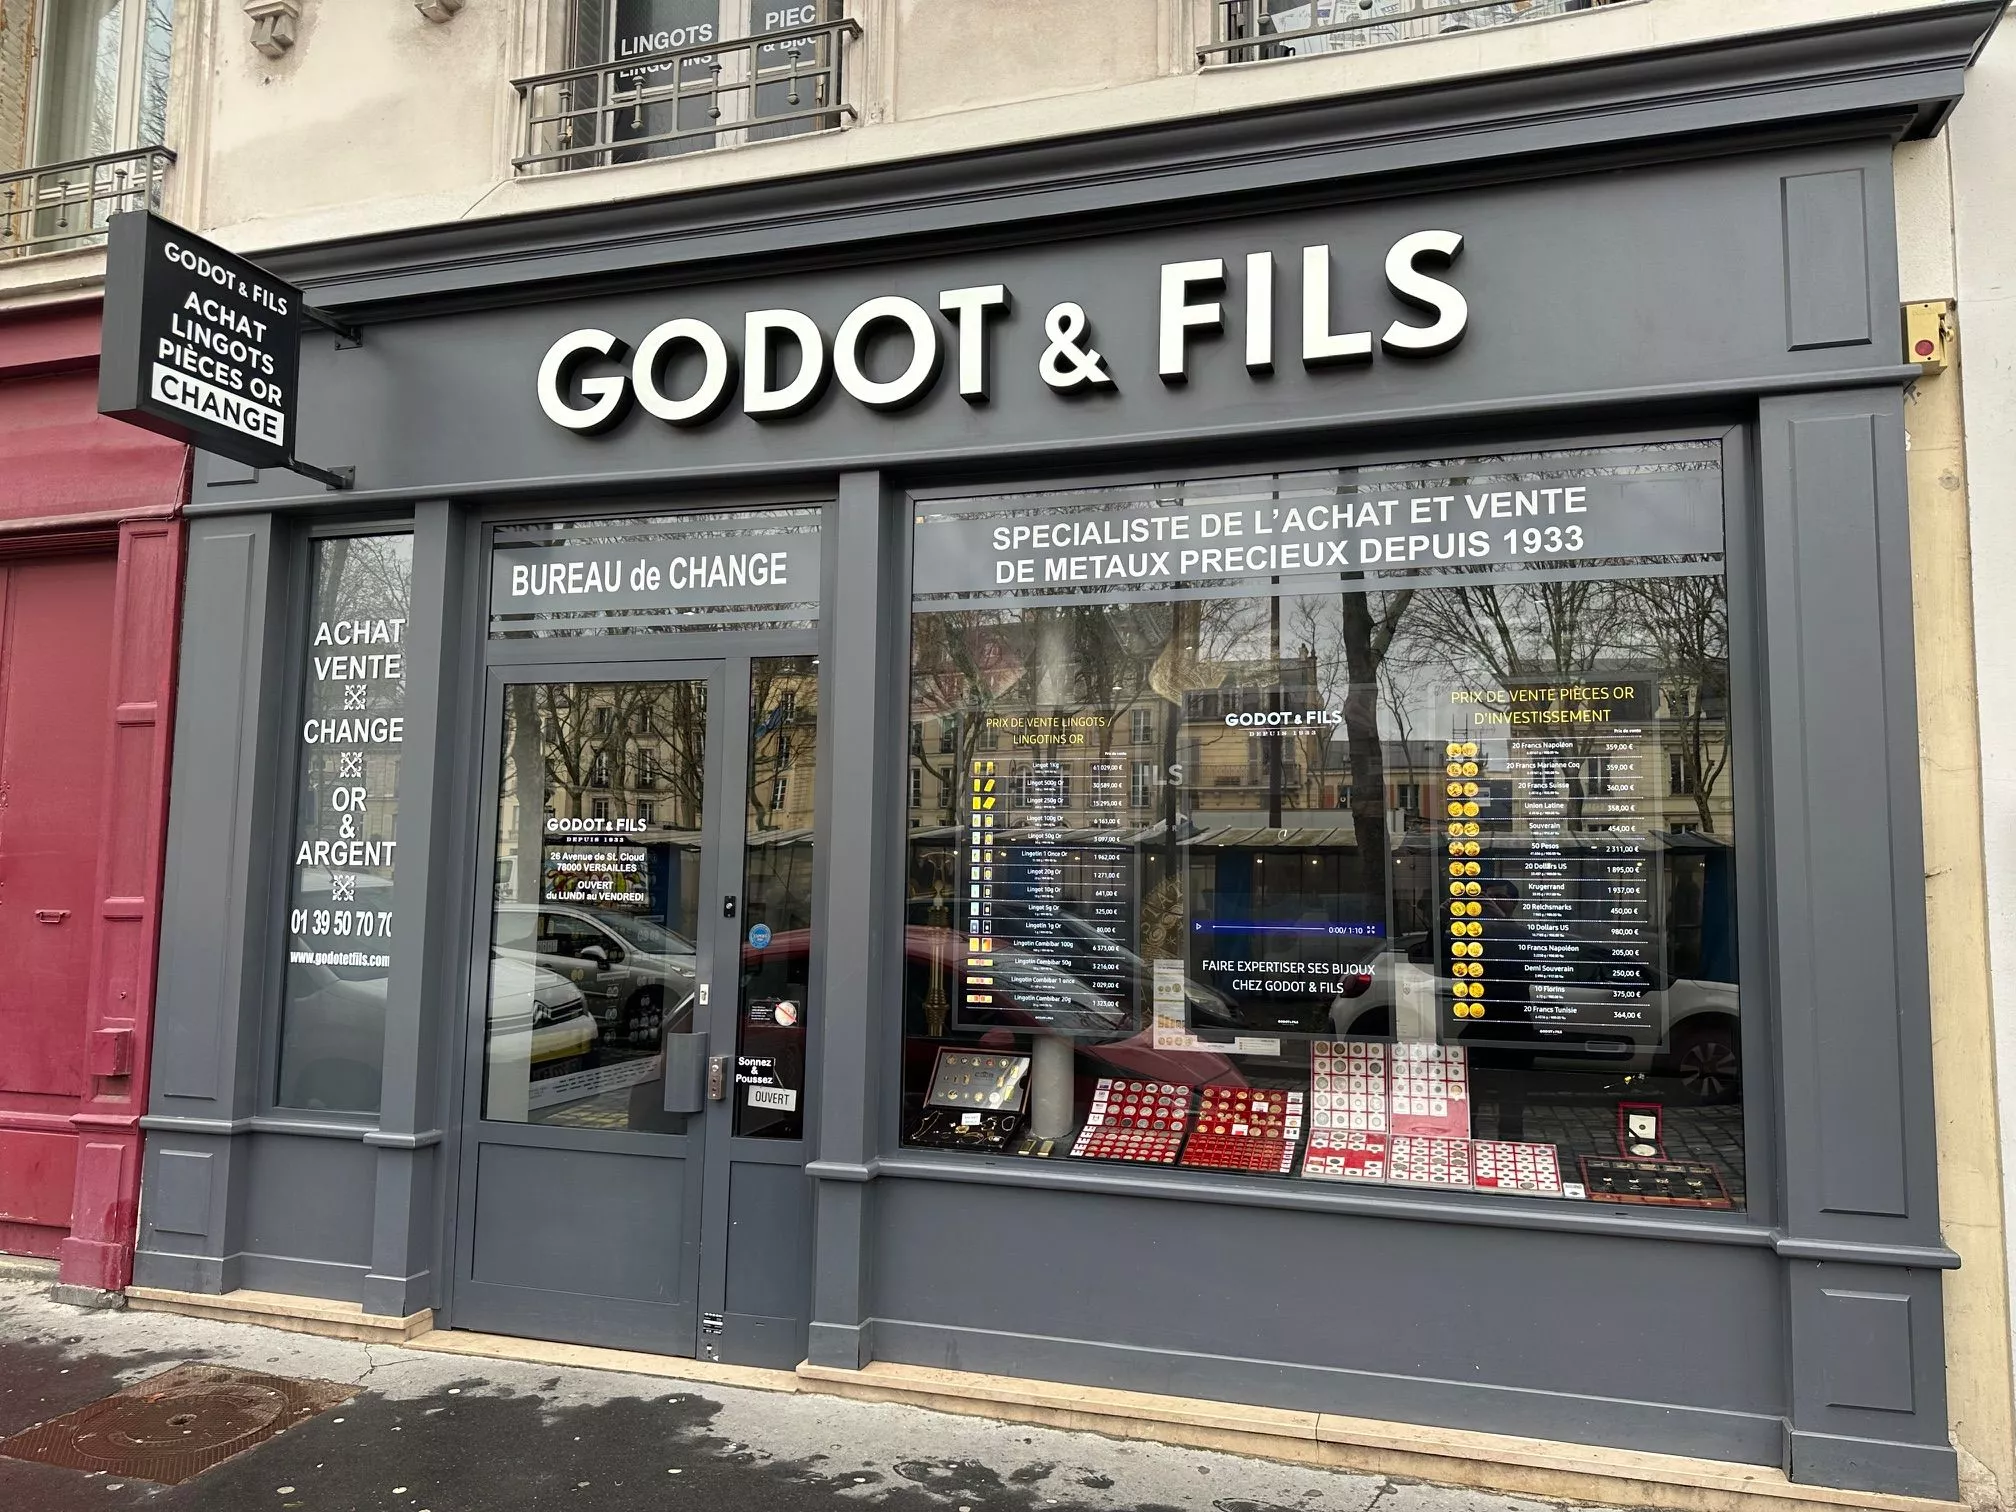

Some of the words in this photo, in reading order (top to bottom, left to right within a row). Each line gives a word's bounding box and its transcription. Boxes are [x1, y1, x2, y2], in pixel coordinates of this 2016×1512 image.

[621, 23, 713, 57] LINGOTS
[164, 241, 236, 290] GODOT
[238, 281, 249, 298] &
[252, 284, 288, 316] FILS
[184, 291, 267, 343] ACHAT
[537, 284, 1008, 432] GODOT
[1039, 301, 1115, 391] &
[1159, 229, 1467, 380] FILS
[172, 313, 274, 375] LINGOTS
[159, 337, 243, 390] PIÈCES
[250, 377, 283, 408] OR
[160, 374, 278, 439] CHANGE
[992, 515, 1190, 550] SPECIALISTE
[1200, 511, 1243, 538] DE
[1254, 500, 1399, 535] L'ACHAT
[1411, 495, 1454, 524] ET
[1464, 486, 1587, 520] VENTE
[996, 559, 1035, 584] DE
[1044, 551, 1171, 582] METAUX
[1180, 540, 1348, 574] PRECIEUX
[1360, 530, 1490, 564] DEPUIS
[1503, 524, 1584, 555] 1933
[511, 560, 622, 596] BUREAU
[629, 558, 660, 591] de
[668, 551, 787, 589] CHANGE
[314, 618, 407, 646] ACHAT
[314, 653, 402, 681] VENTE
[1451, 691, 1484, 704] PRIX
[1486, 690, 1506, 702] DE
[1509, 688, 1556, 702] VENTE
[1560, 685, 1609, 701] PIÈCES
[1613, 686, 1635, 699] OR
[986, 717, 1008, 728] PRIX
[1010, 717, 1024, 727] DE
[1026, 717, 1059, 728] VENTE
[1062, 716, 1105, 727] LINGOTS
[1225, 711, 1292, 727] GODOT
[1294, 714, 1303, 725] &
[1306, 709, 1343, 725] FILS
[1474, 709, 1611, 725] D'INVESTISSEMENT
[303, 717, 404, 744] CHANGE
[1013, 734, 1067, 745] LINGOTINS
[1069, 734, 1084, 744] OR
[1605, 743, 1627, 751] 359,00
[1537, 761, 1567, 769] Marianne
[1567, 761, 1580, 770] Coq
[1605, 763, 1628, 771] 359,00
[1629, 763, 1634, 771] €
[1606, 784, 1629, 792] 360,00
[332, 786, 368, 813] OR
[1607, 804, 1630, 812] 358,00
[1630, 804, 1635, 812] €
[338, 813, 356, 839] &
[546, 817, 605, 832] GODOT
[605, 820, 613, 832] &
[616, 818, 647, 832] FILS
[1528, 822, 1561, 830] Souverain
[1607, 825, 1630, 833] 454,00
[296, 840, 397, 866] ARGENT
[1531, 842, 1540, 850] 50
[1540, 842, 1560, 850] Pesos
[1610, 846, 1634, 854] 311,00
[550, 852, 561, 860] 26
[562, 852, 593, 861] Avenue
[593, 852, 606, 861] de
[606, 853, 618, 861] St.
[619, 853, 645, 862] Cloud
[557, 863, 582, 872] 78000
[583, 863, 637, 873] VERSAILLES
[577, 880, 614, 890] OUVERT
[1528, 883, 1565, 891] Krugerrand
[1611, 887, 1635, 895] 937,00
[545, 891, 557, 900] du
[558, 891, 585, 900] LUNDI
[586, 893, 597, 901] au
[598, 892, 644, 902] VENDREDI
[1522, 903, 1531, 911] 20
[1531, 903, 1572, 911] Reichsmarks
[1610, 907, 1633, 915] 450,00
[291, 908, 308, 934] 01
[312, 909, 331, 935] 39
[333, 910, 352, 936] 50
[355, 911, 374, 937] 70
[1348, 927, 1364, 935] 1:10
[290, 951, 390, 967] www.godotetfils.com
[1202, 960, 1235, 972] FAIRE
[1237, 961, 1305, 974] EXPERTISER
[1307, 962, 1329, 974] SES
[1332, 963, 1376, 976] BIJOUX
[1232, 979, 1263, 991] CHEZ
[1265, 981, 1306, 993] GODOT
[1308, 982, 1318, 993] &
[1319, 982, 1344, 994] FILS
[738, 1056, 772, 1067] Sonnez
[750, 1066, 759, 1075] &
[735, 1074, 773, 1084] Poussez
[755, 1090, 790, 1106] OUVERT
